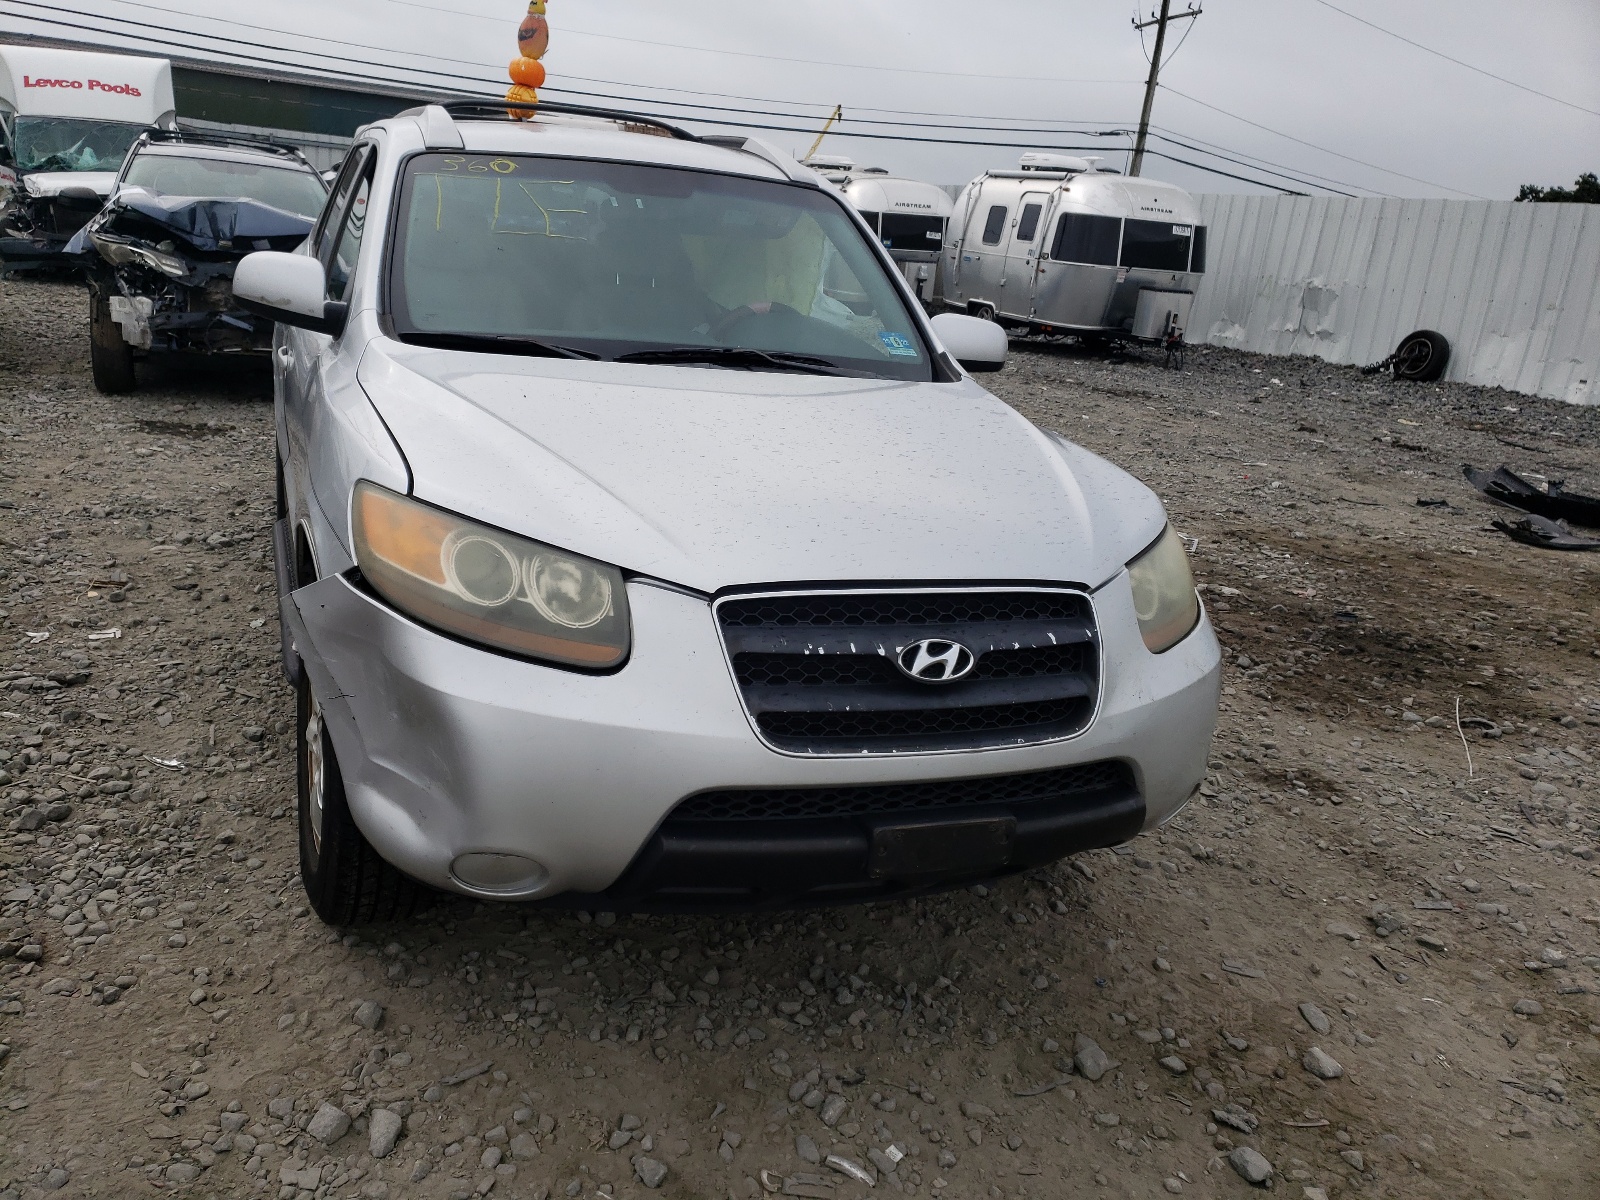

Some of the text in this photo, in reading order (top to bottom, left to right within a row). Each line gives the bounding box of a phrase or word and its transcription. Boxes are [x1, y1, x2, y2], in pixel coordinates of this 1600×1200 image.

[23, 75, 142, 97] Levco Pools
[1140, 206, 1173, 214] AIRSTREAM
